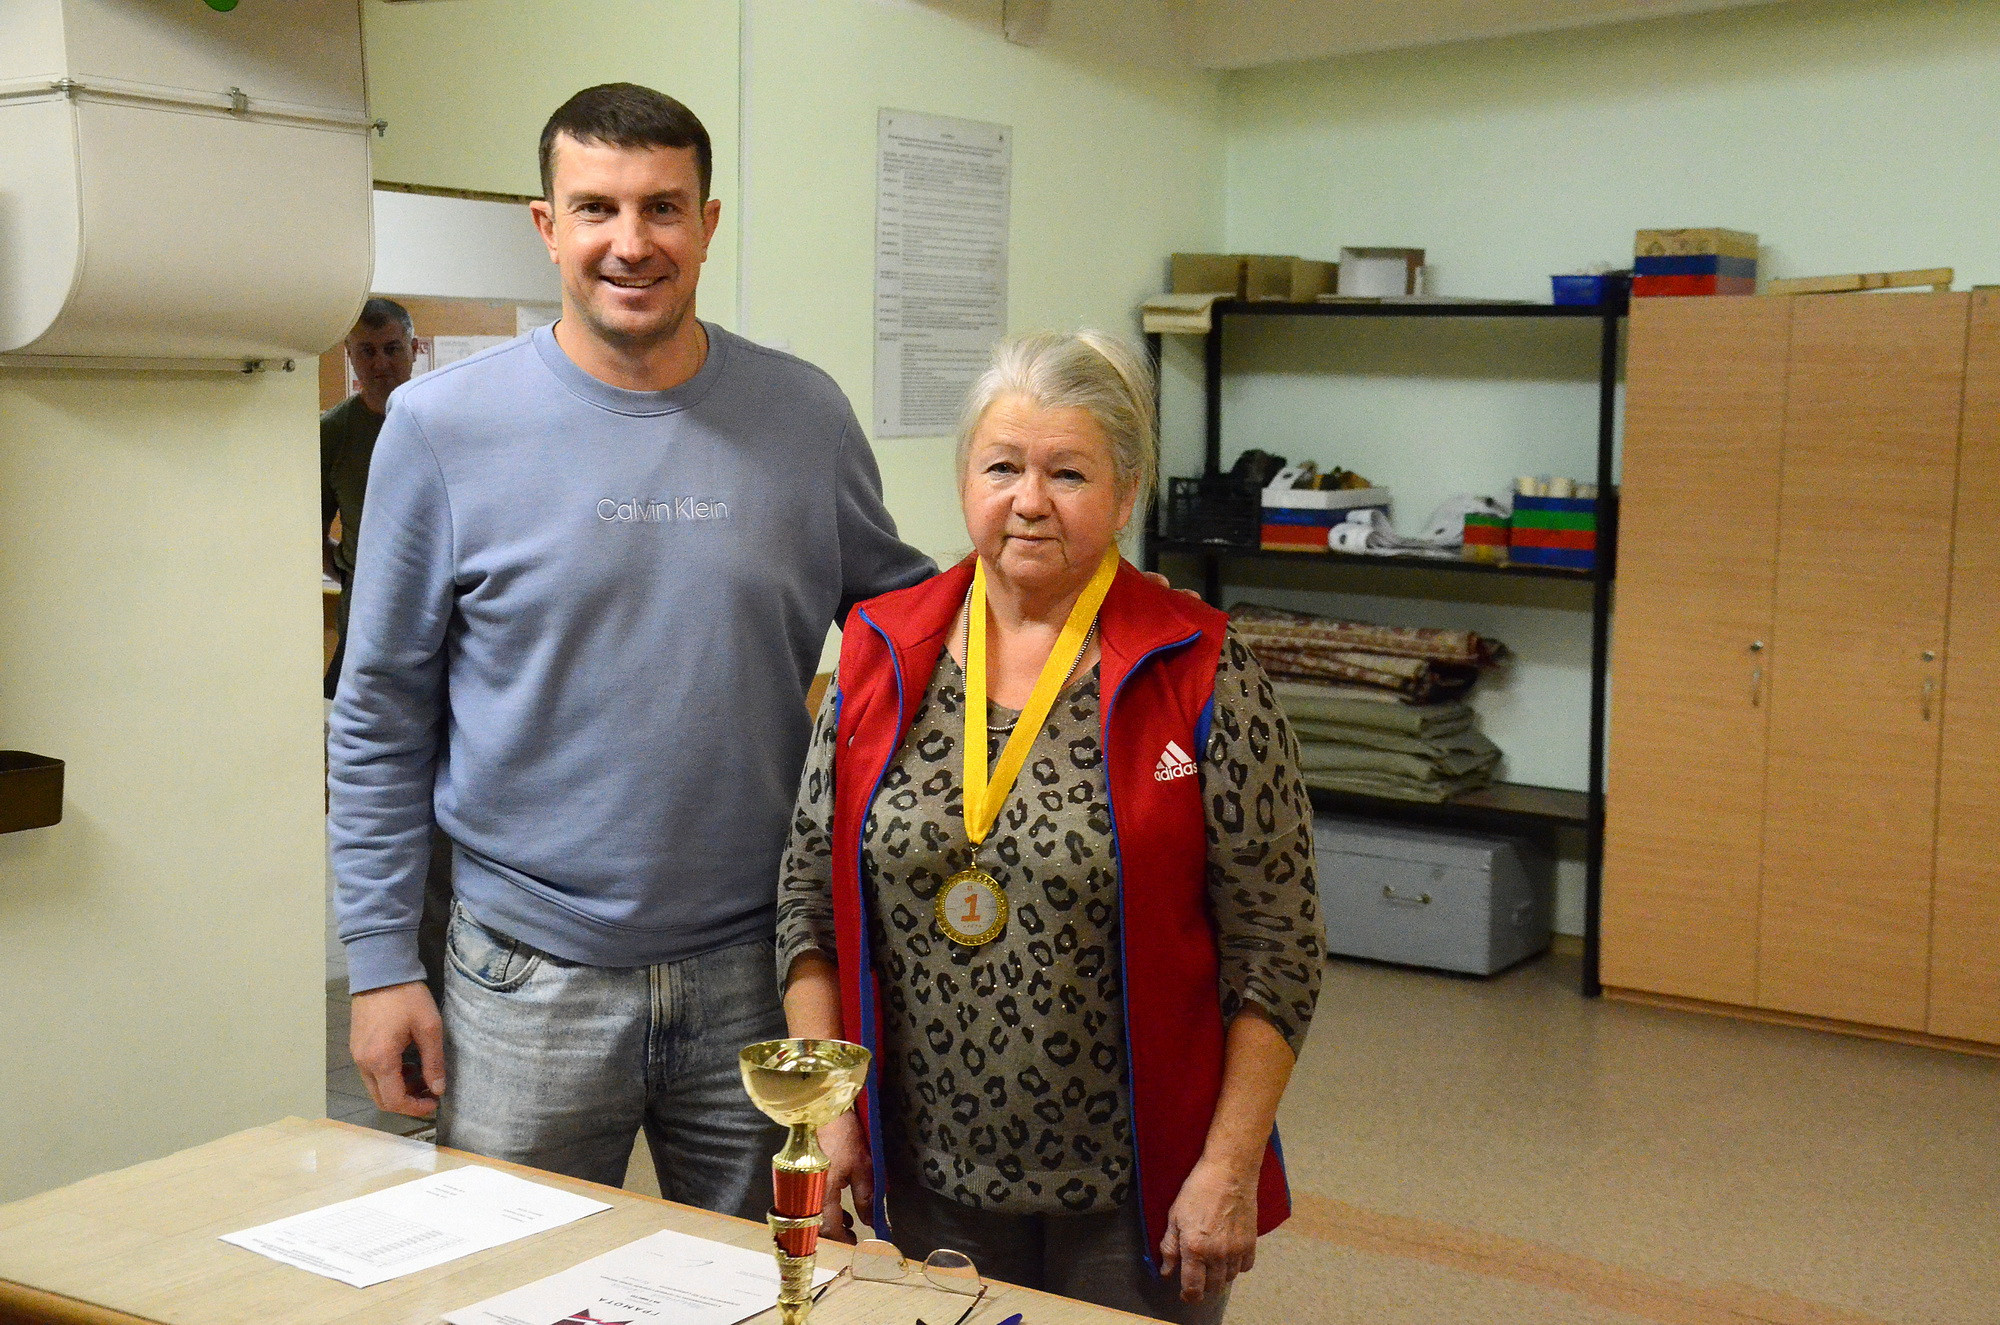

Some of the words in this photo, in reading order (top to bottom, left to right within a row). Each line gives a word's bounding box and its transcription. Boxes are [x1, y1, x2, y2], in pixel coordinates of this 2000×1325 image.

[597, 498, 670, 521] Calvin
[675, 497, 728, 519] Klein
[1154, 762, 1198, 781] adidas
[960, 894, 981, 922] 1
[599, 1298, 661, 1316] ГРАМОТА
